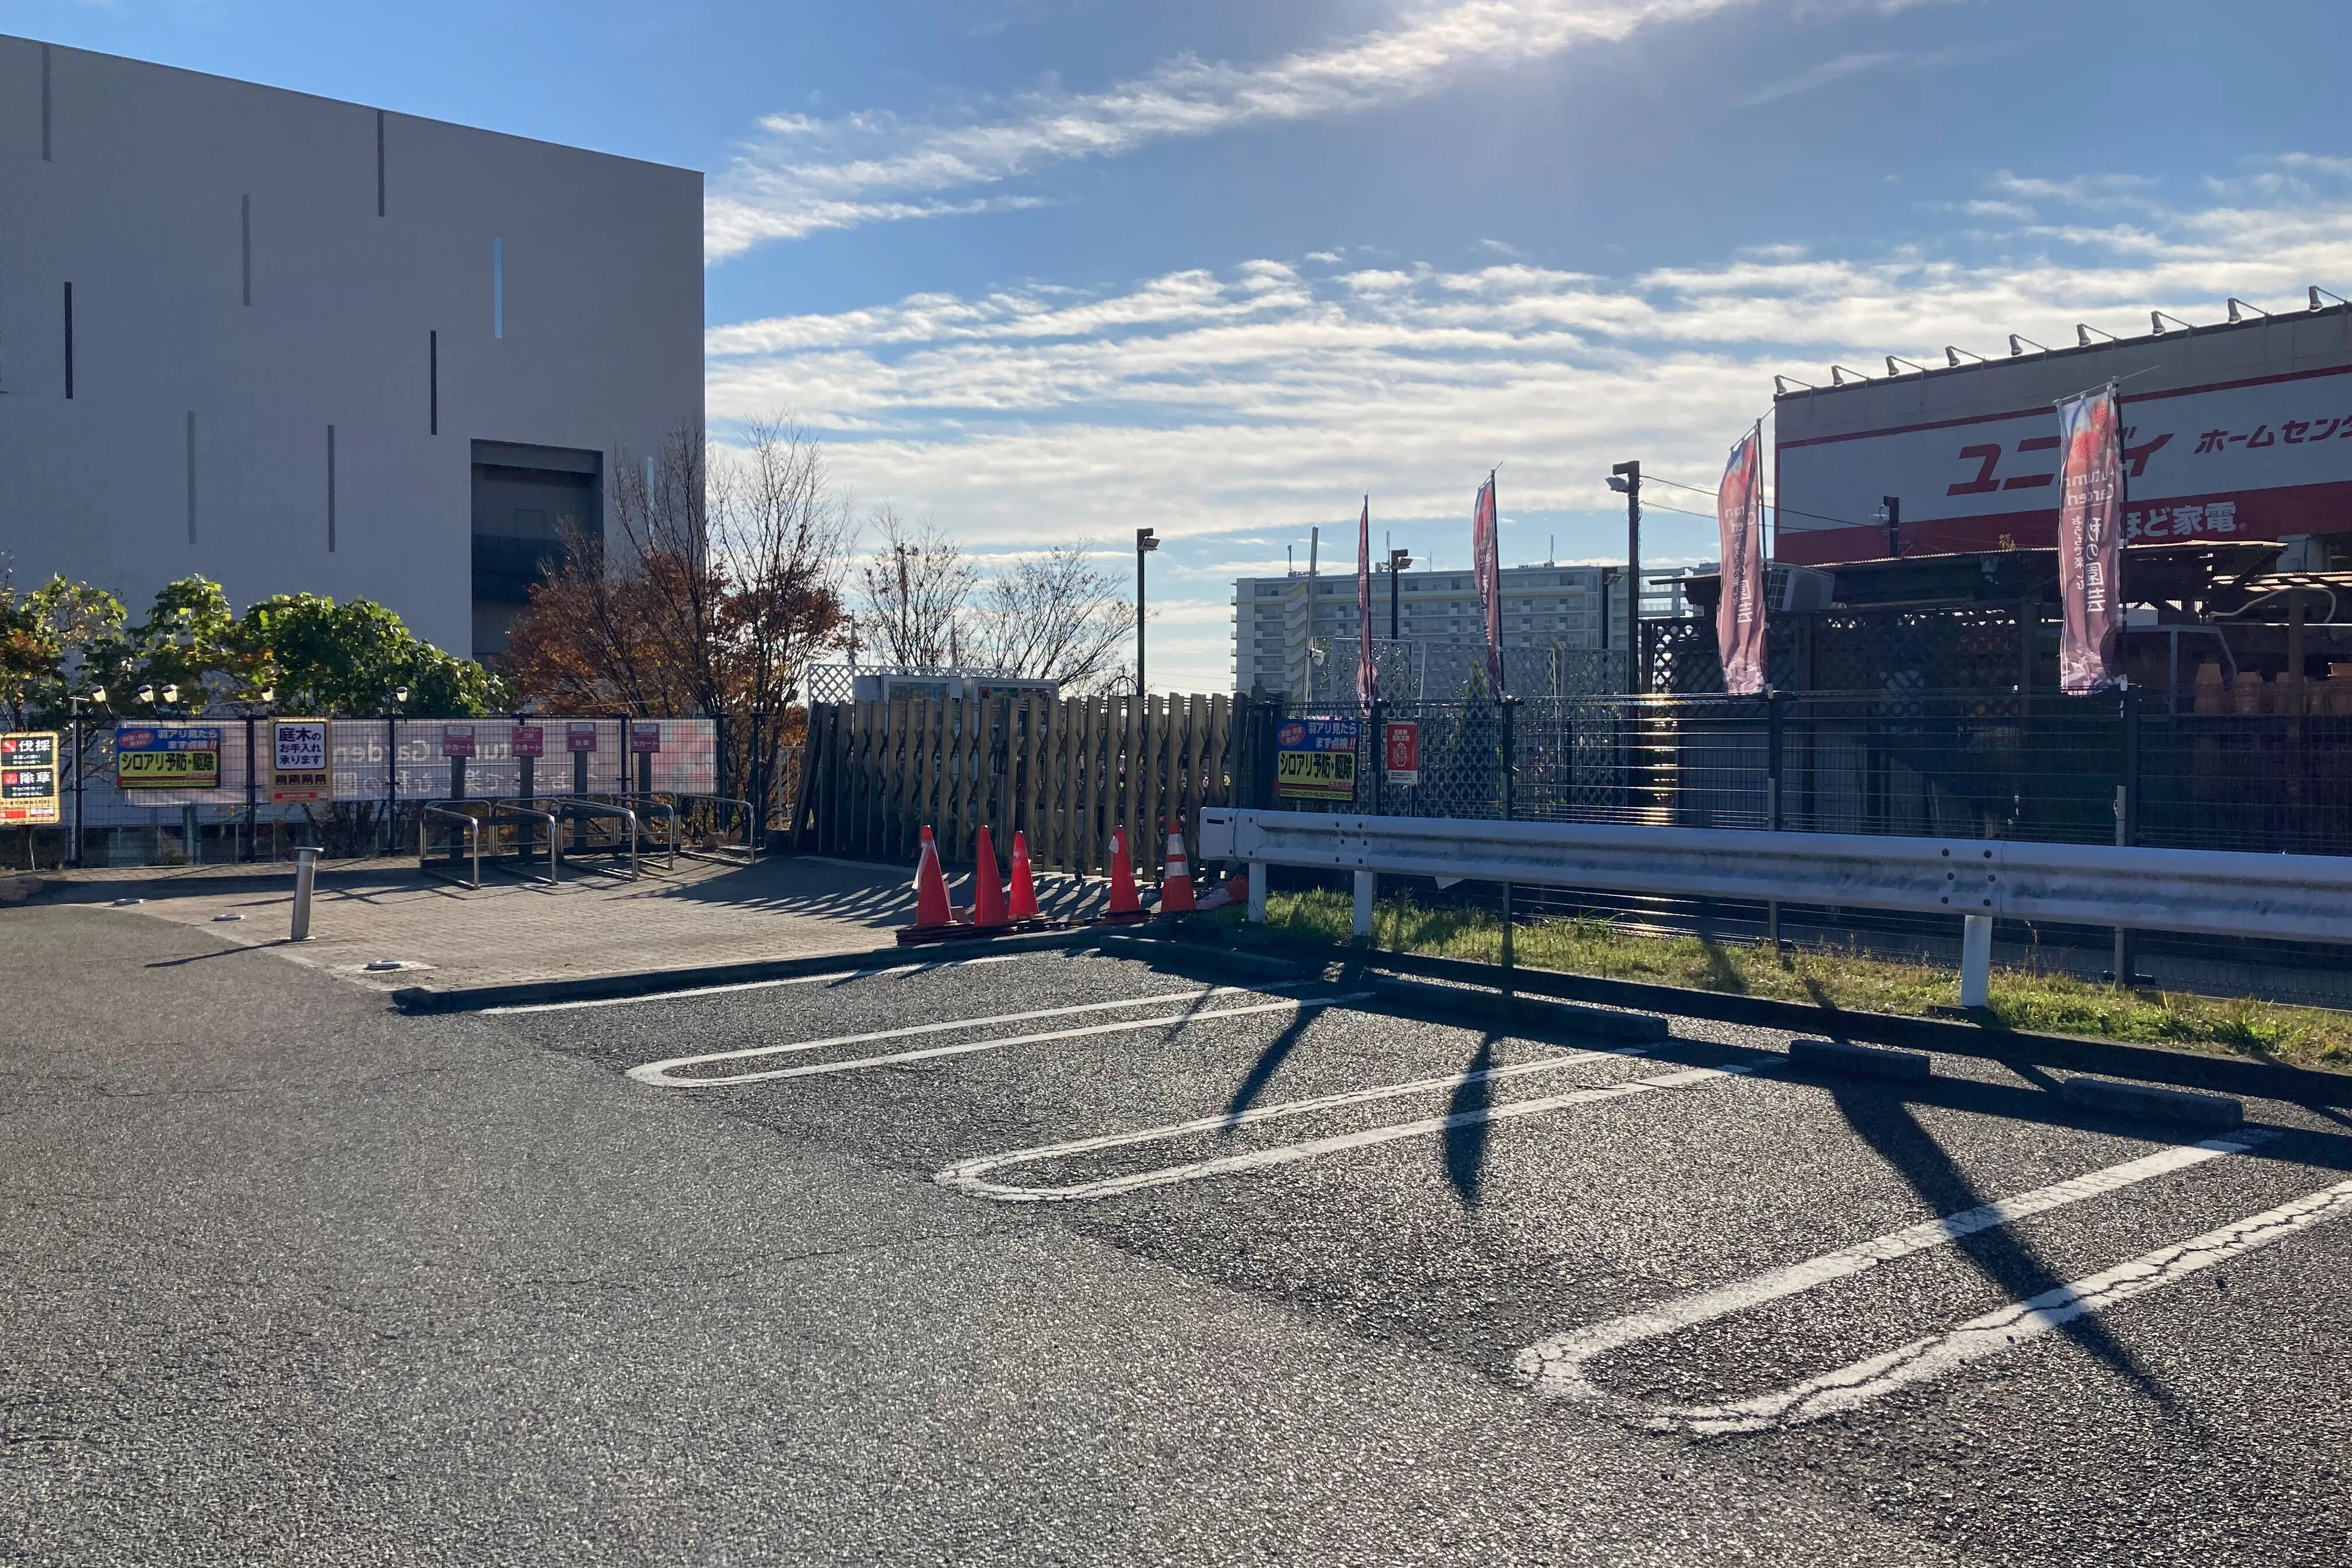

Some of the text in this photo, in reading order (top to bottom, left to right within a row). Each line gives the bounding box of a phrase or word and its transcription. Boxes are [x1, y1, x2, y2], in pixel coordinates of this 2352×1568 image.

[279, 727, 321, 742] 庭木の
[1308, 722, 1357, 735] 羽アリ見たら
[19, 739, 50, 752] 伐採
[279, 743, 321, 753] お手入れ
[122, 752, 214, 772] シロアリ予防・駆除
[279, 754, 322, 765] 承ります
[1280, 752, 1353, 779] シロアリ予防・駆除
[20, 771, 51, 785] 除草
